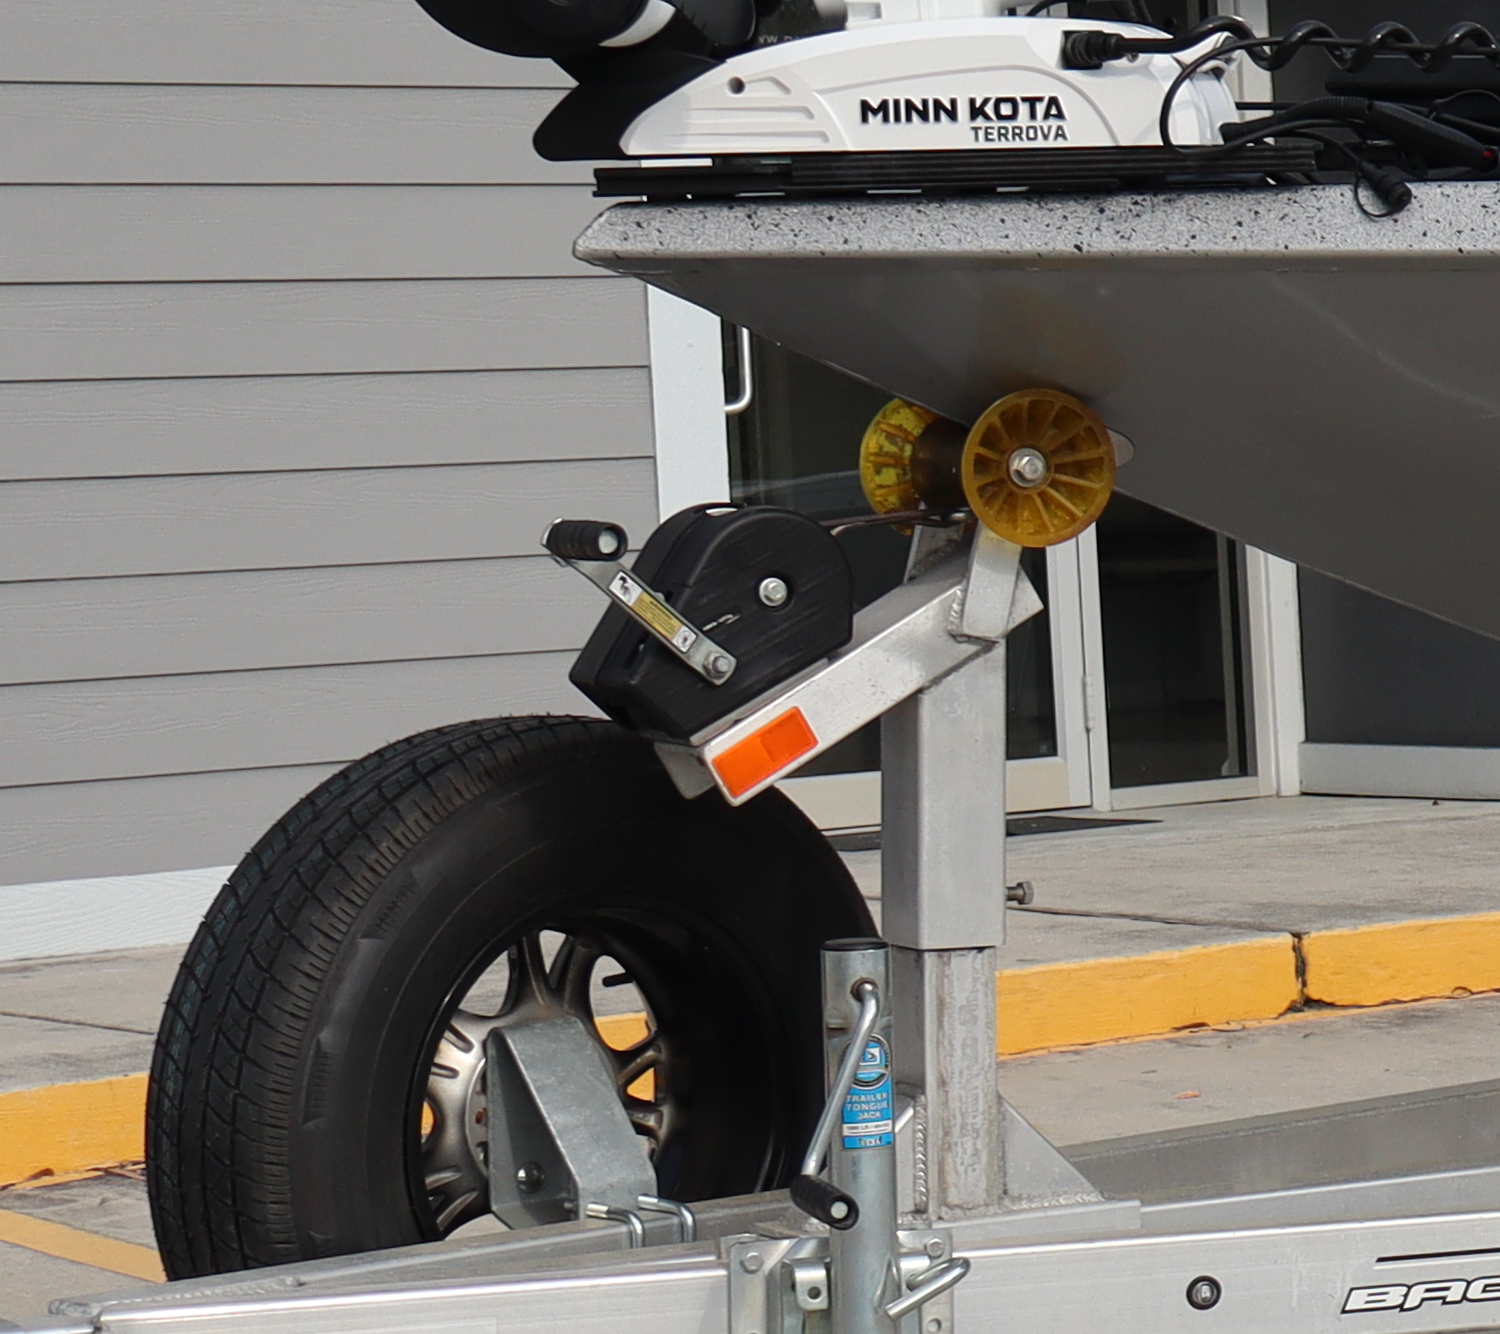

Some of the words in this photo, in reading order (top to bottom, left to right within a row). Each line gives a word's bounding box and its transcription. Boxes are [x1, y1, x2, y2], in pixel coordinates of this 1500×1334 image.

[860, 97, 958, 124] MINN
[968, 95, 1067, 122] KOTA
[970, 124, 1069, 143] TERROVA
